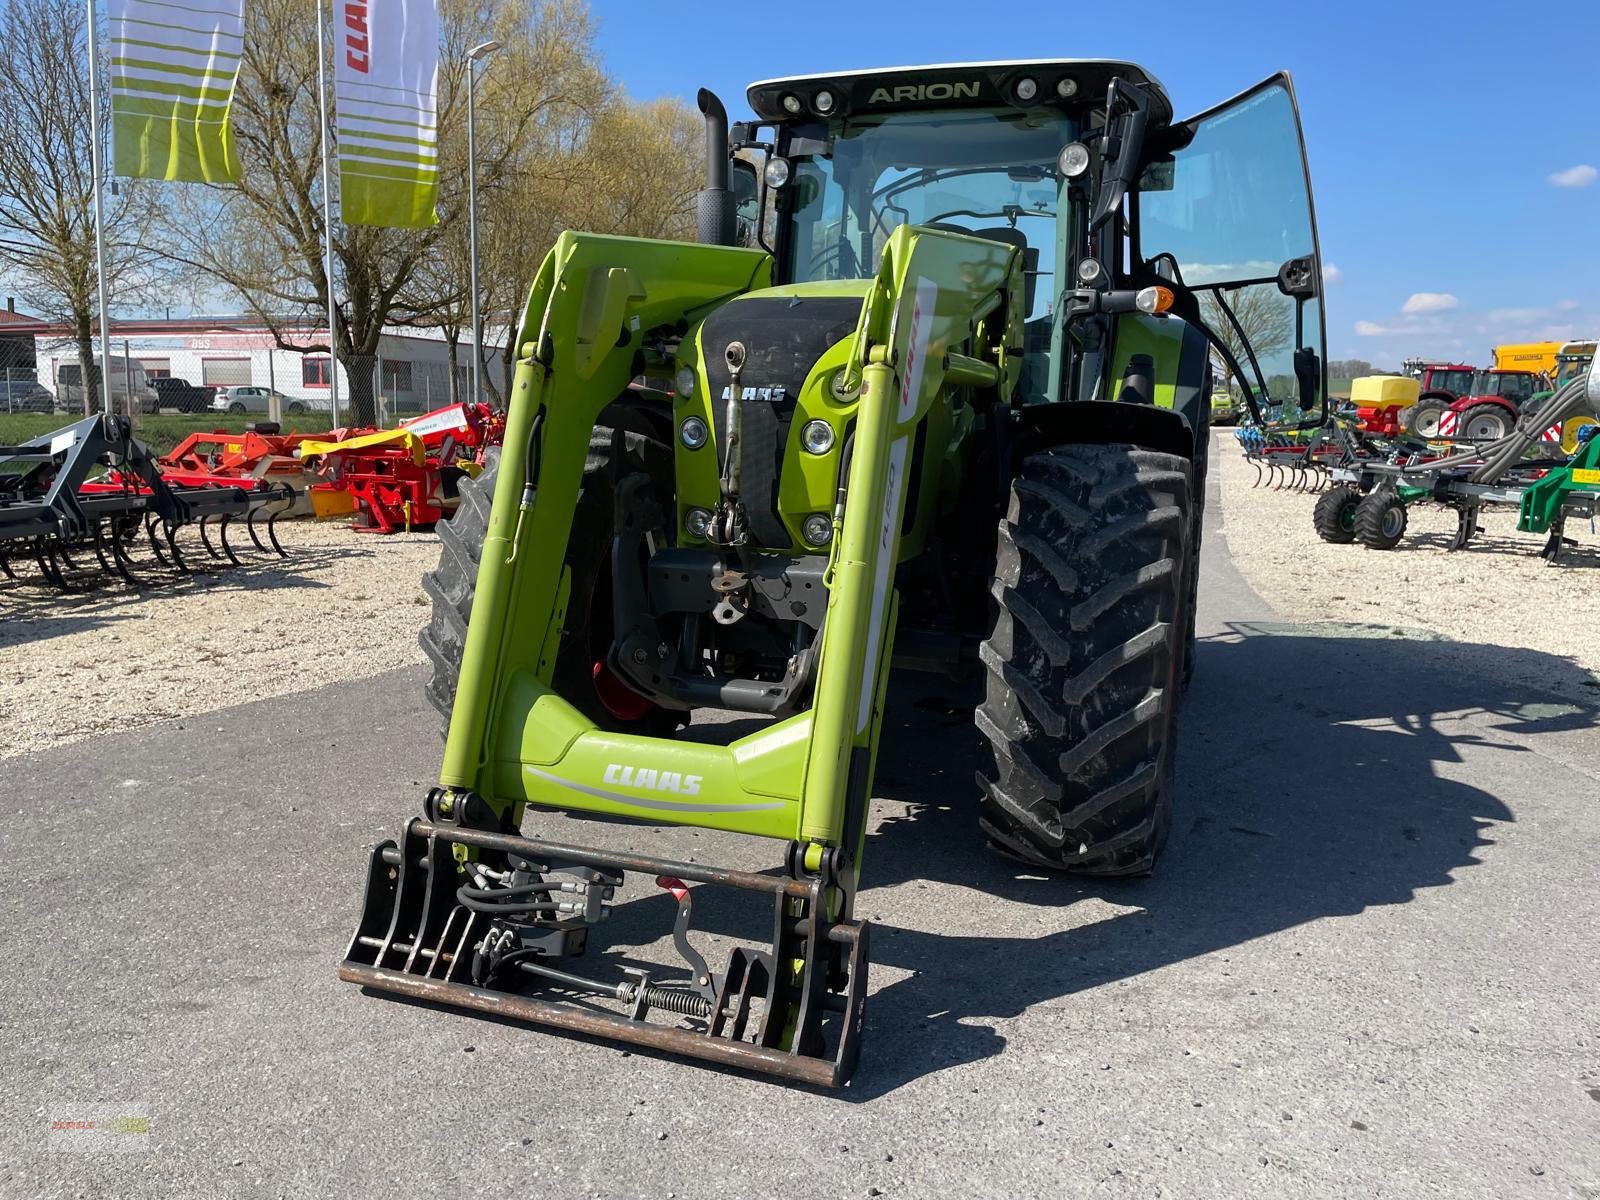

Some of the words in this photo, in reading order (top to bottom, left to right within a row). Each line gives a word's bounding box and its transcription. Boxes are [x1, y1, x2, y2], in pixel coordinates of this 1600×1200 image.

[344, 0, 369, 74] CLA
[868, 81, 980, 104] ARION
[902, 302, 921, 407] CLAAS
[602, 763, 704, 796] CLAAS
